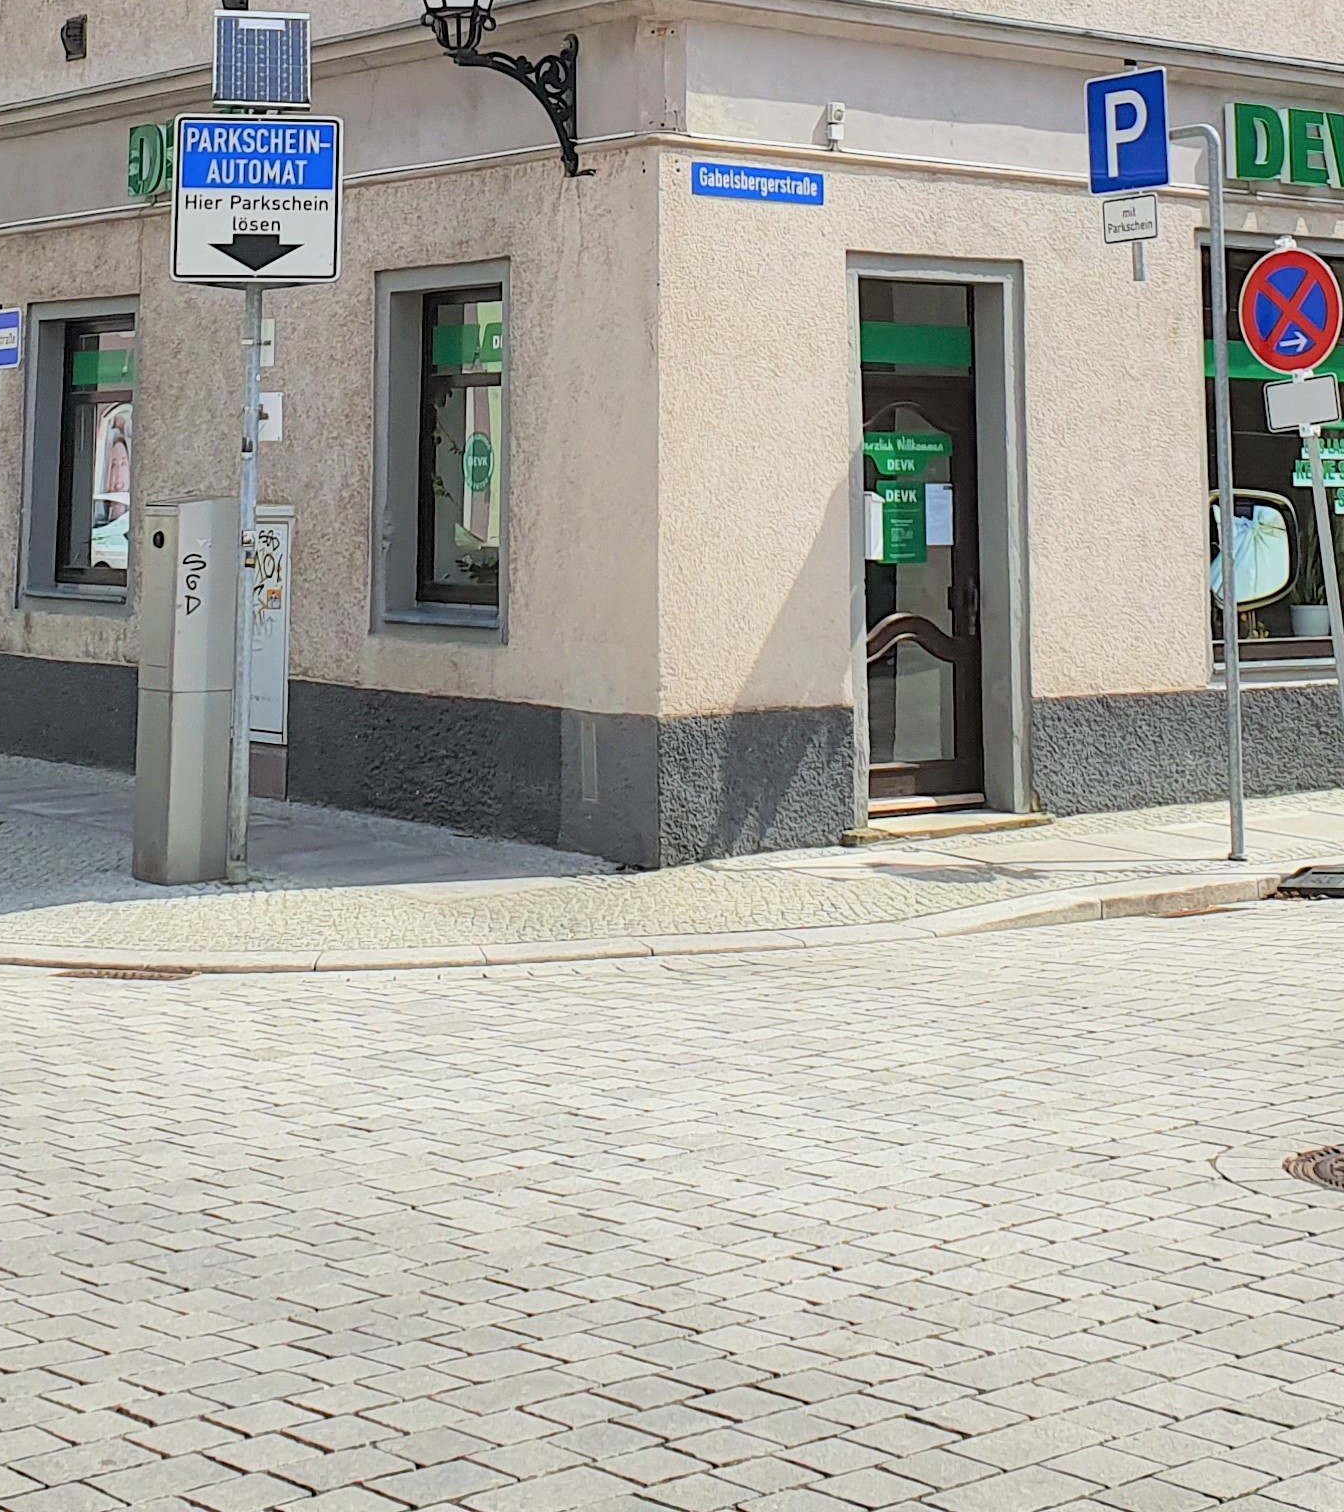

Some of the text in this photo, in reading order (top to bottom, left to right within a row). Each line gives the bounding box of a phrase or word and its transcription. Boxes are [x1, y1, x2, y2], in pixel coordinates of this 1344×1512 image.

[186, 127, 331, 155] PARKSCHEIN-
[1105, 90, 1147, 178] P
[206, 158, 308, 185] AUTOMAT
[699, 166, 818, 197] Gabelsbergerstraße
[185, 194, 329, 212] Hier Parkschein
[1122, 207, 1136, 219] mit
[232, 216, 281, 232] lösen
[1107, 219, 1153, 234] Parkschein
[863, 437, 894, 451] erzlich
[467, 455, 488, 467] DEVK
[886, 458, 915, 471] DEVK
[885, 489, 917, 503] DEVK
